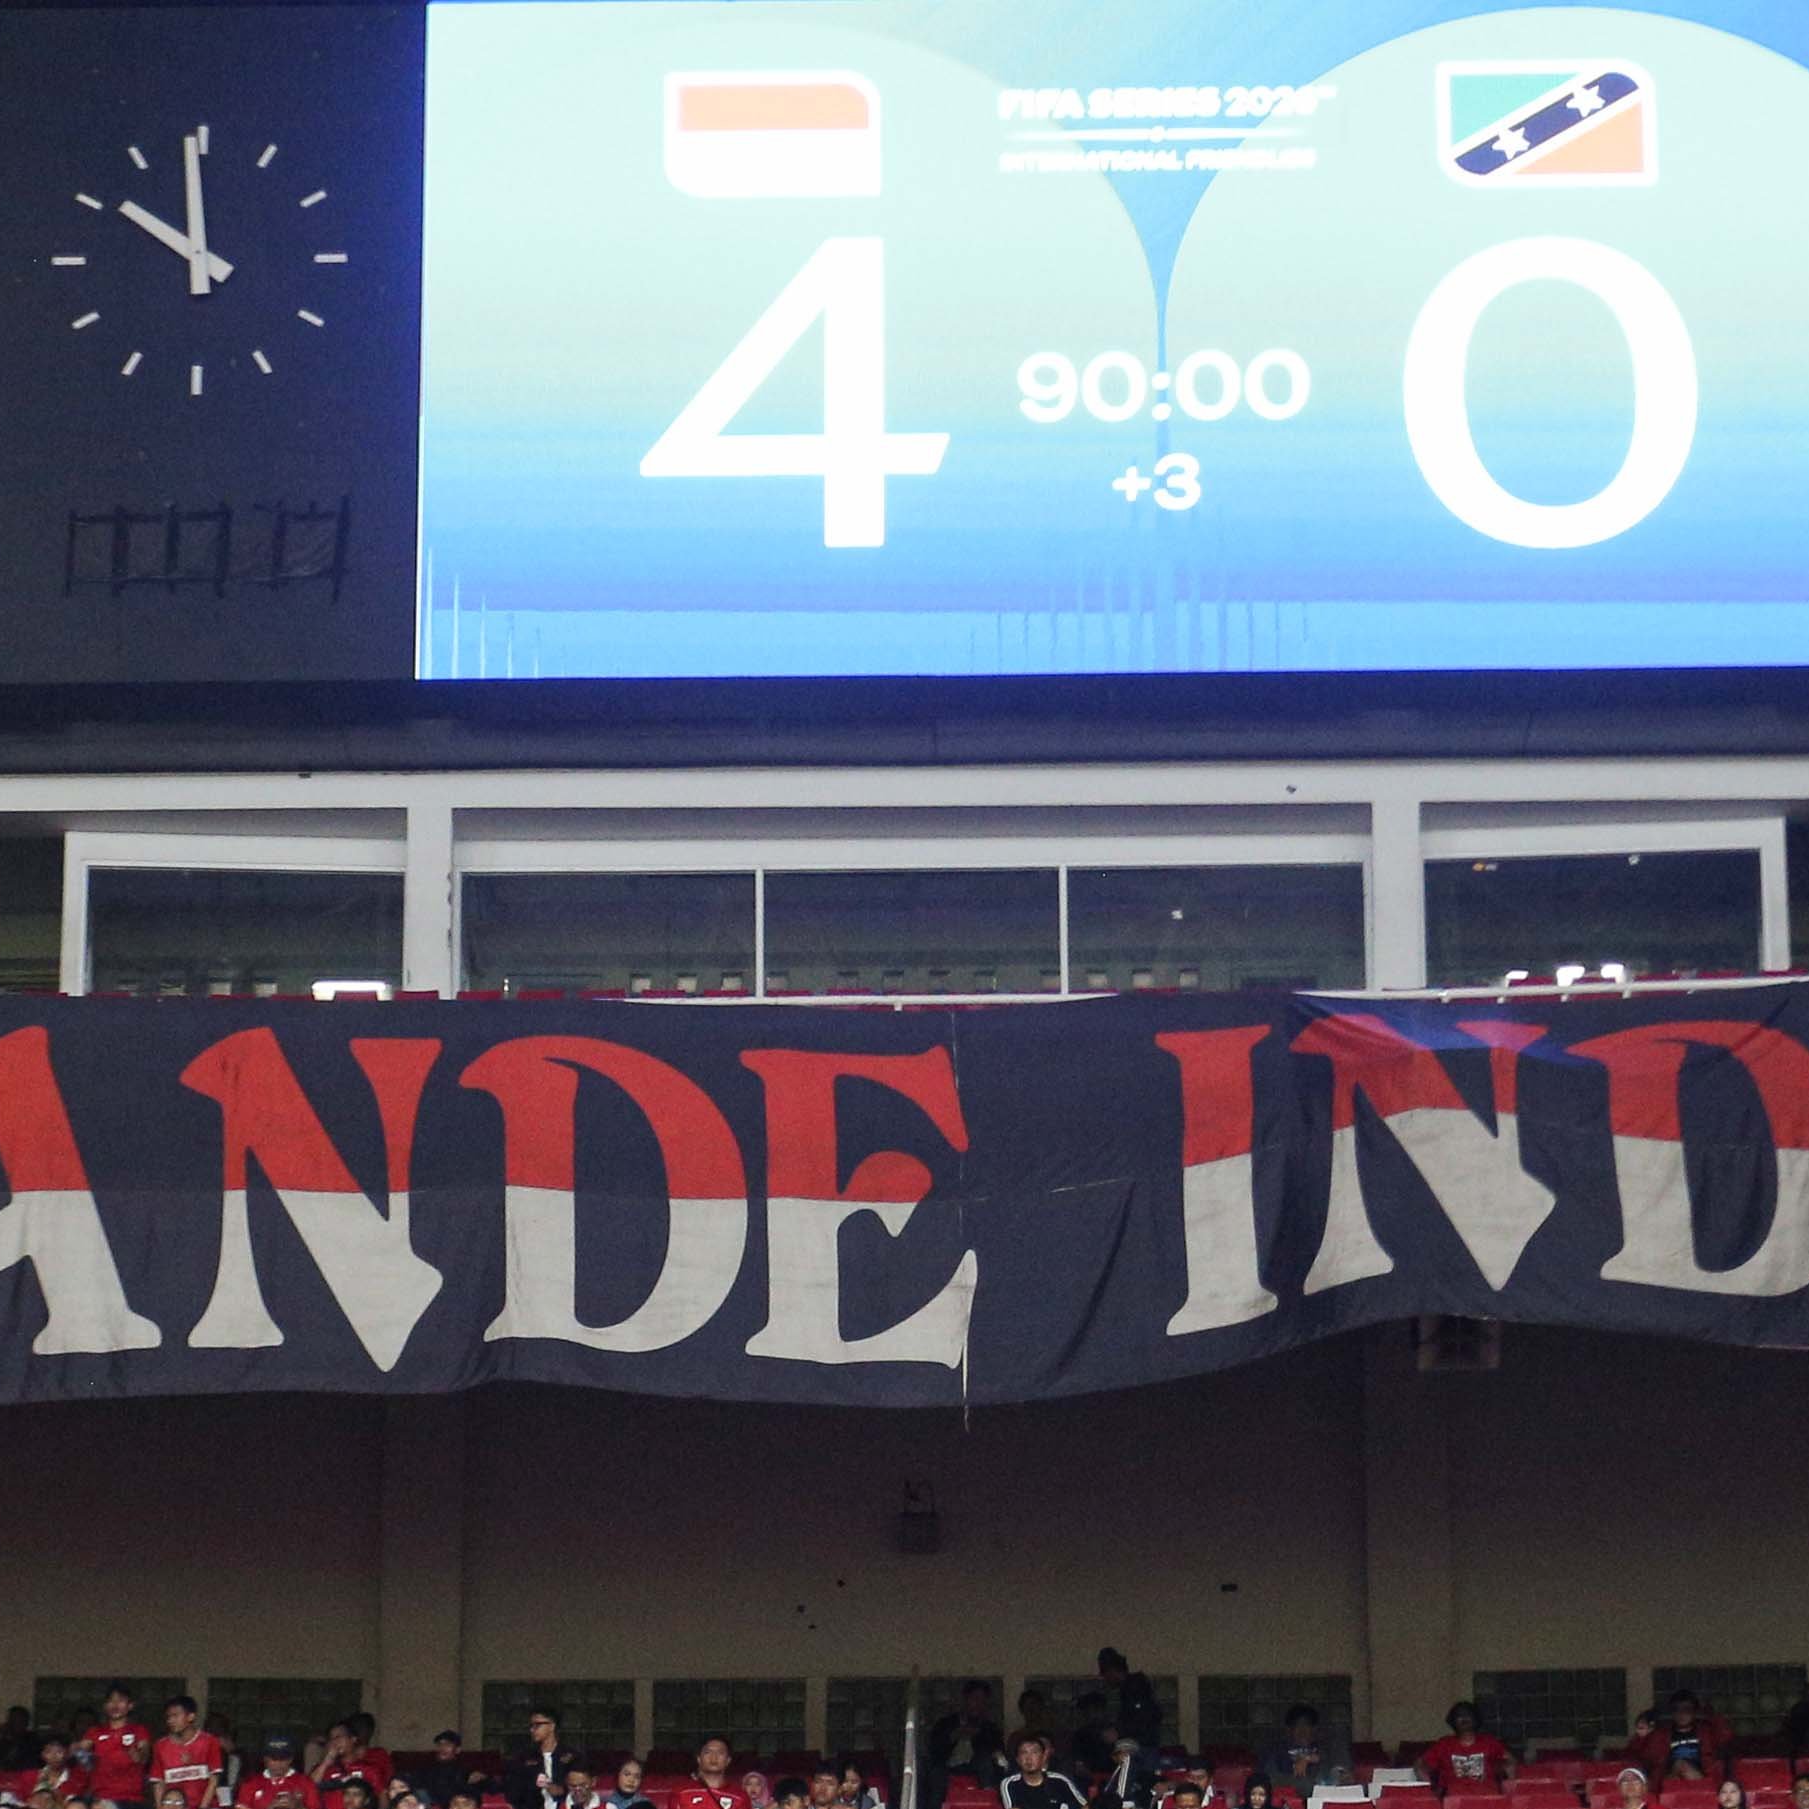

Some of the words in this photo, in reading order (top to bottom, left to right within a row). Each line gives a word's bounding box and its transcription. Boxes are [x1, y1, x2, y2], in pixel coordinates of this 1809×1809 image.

[638, 236, 950, 548] 4
[1017, 349, 1311, 423] 90:00
[1112, 453, 1202, 511] +3
[1403, 235, 1698, 548] 0
